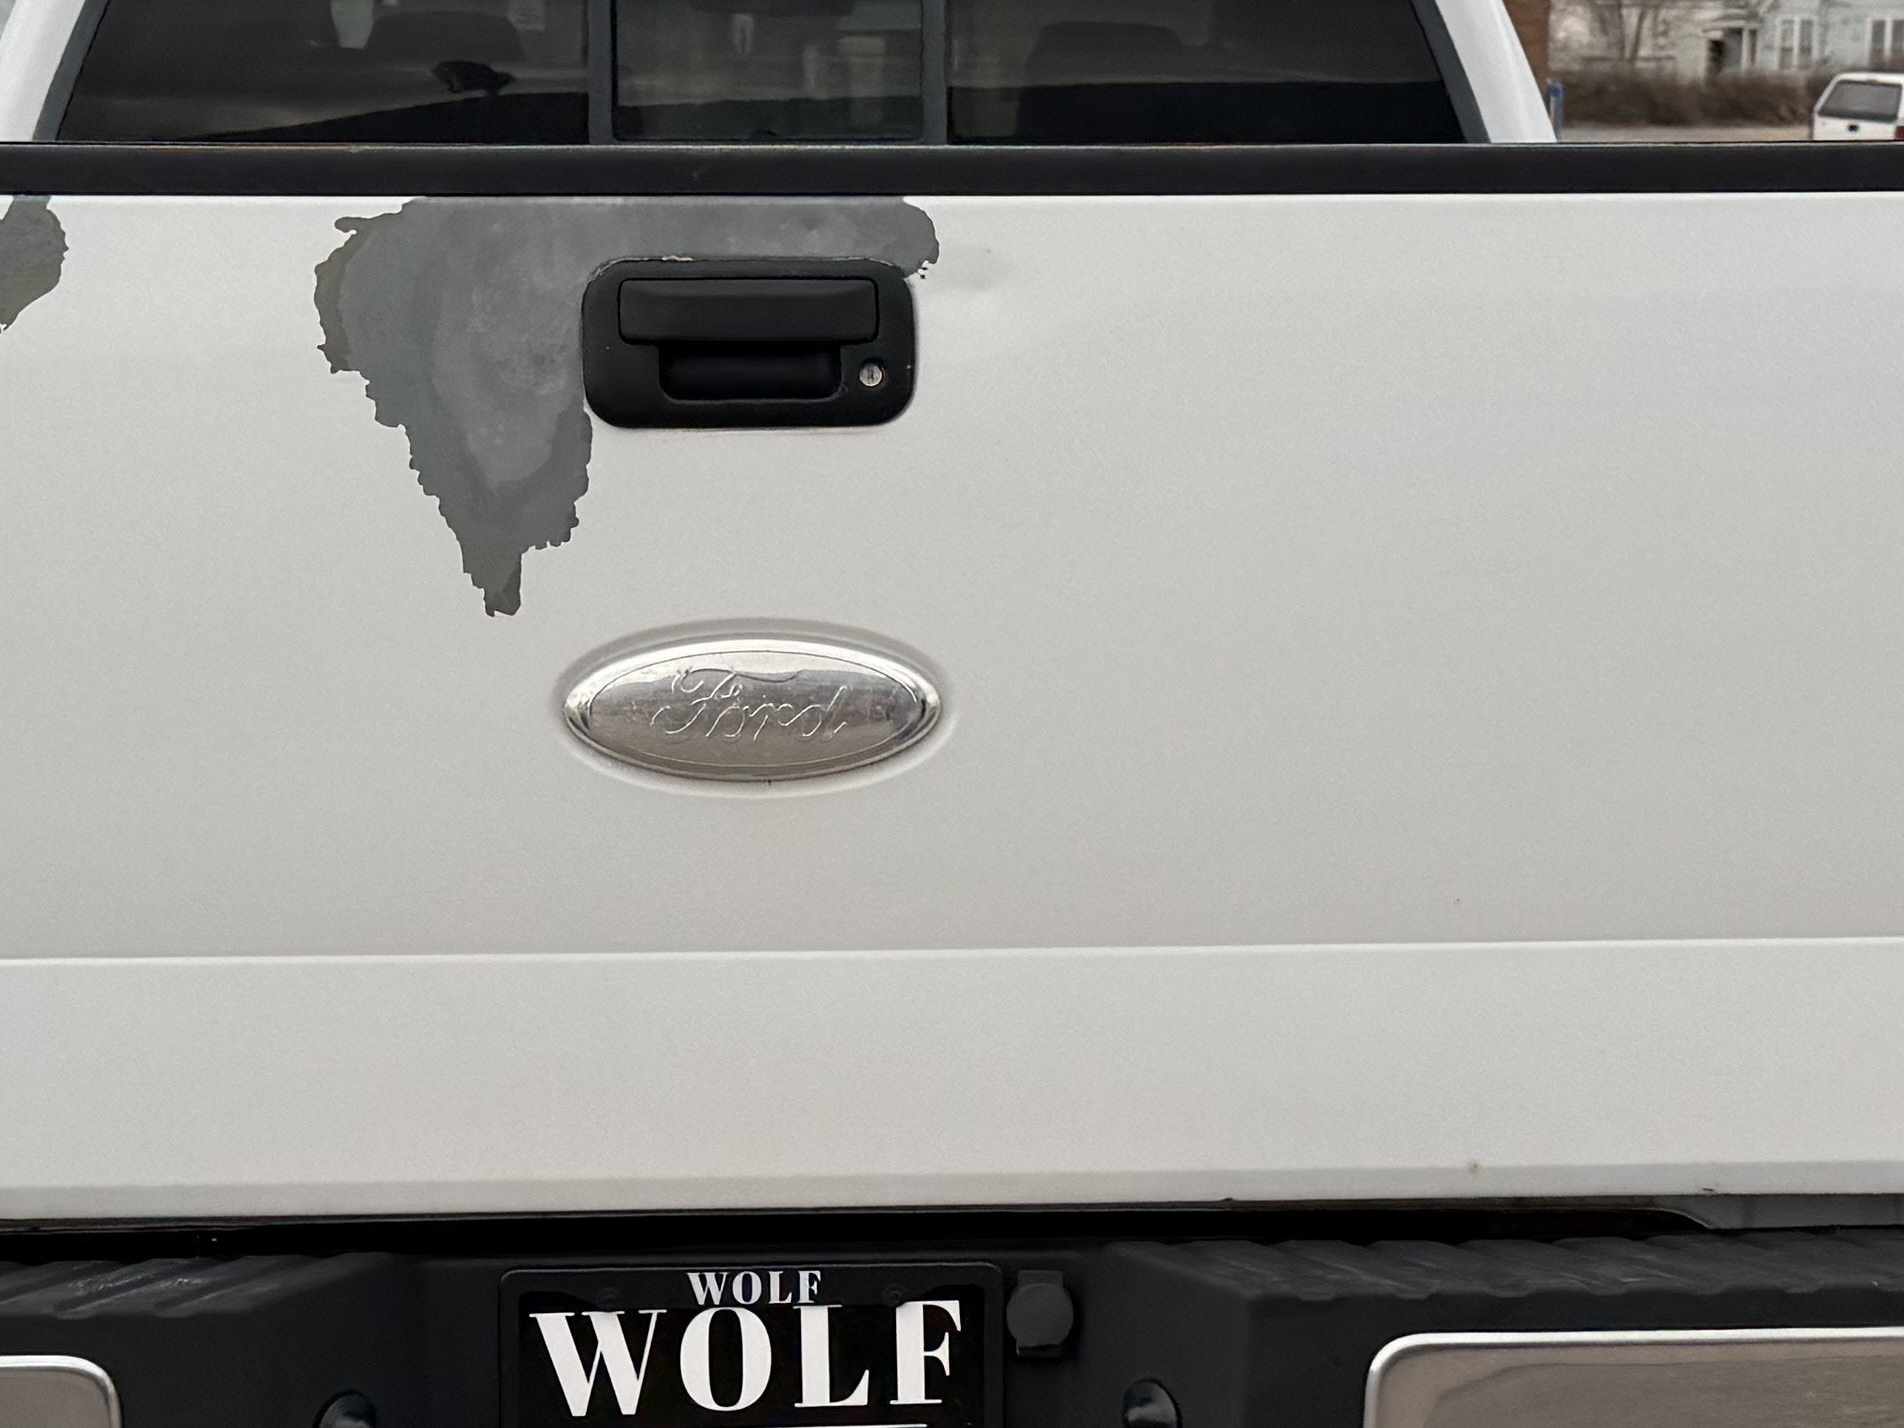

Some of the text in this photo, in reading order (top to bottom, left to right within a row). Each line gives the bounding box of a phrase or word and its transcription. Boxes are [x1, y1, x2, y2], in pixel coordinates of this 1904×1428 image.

[649, 668, 848, 741] Ford
[686, 1269, 822, 1306] WOLF
[529, 1299, 963, 1418] WOLF
